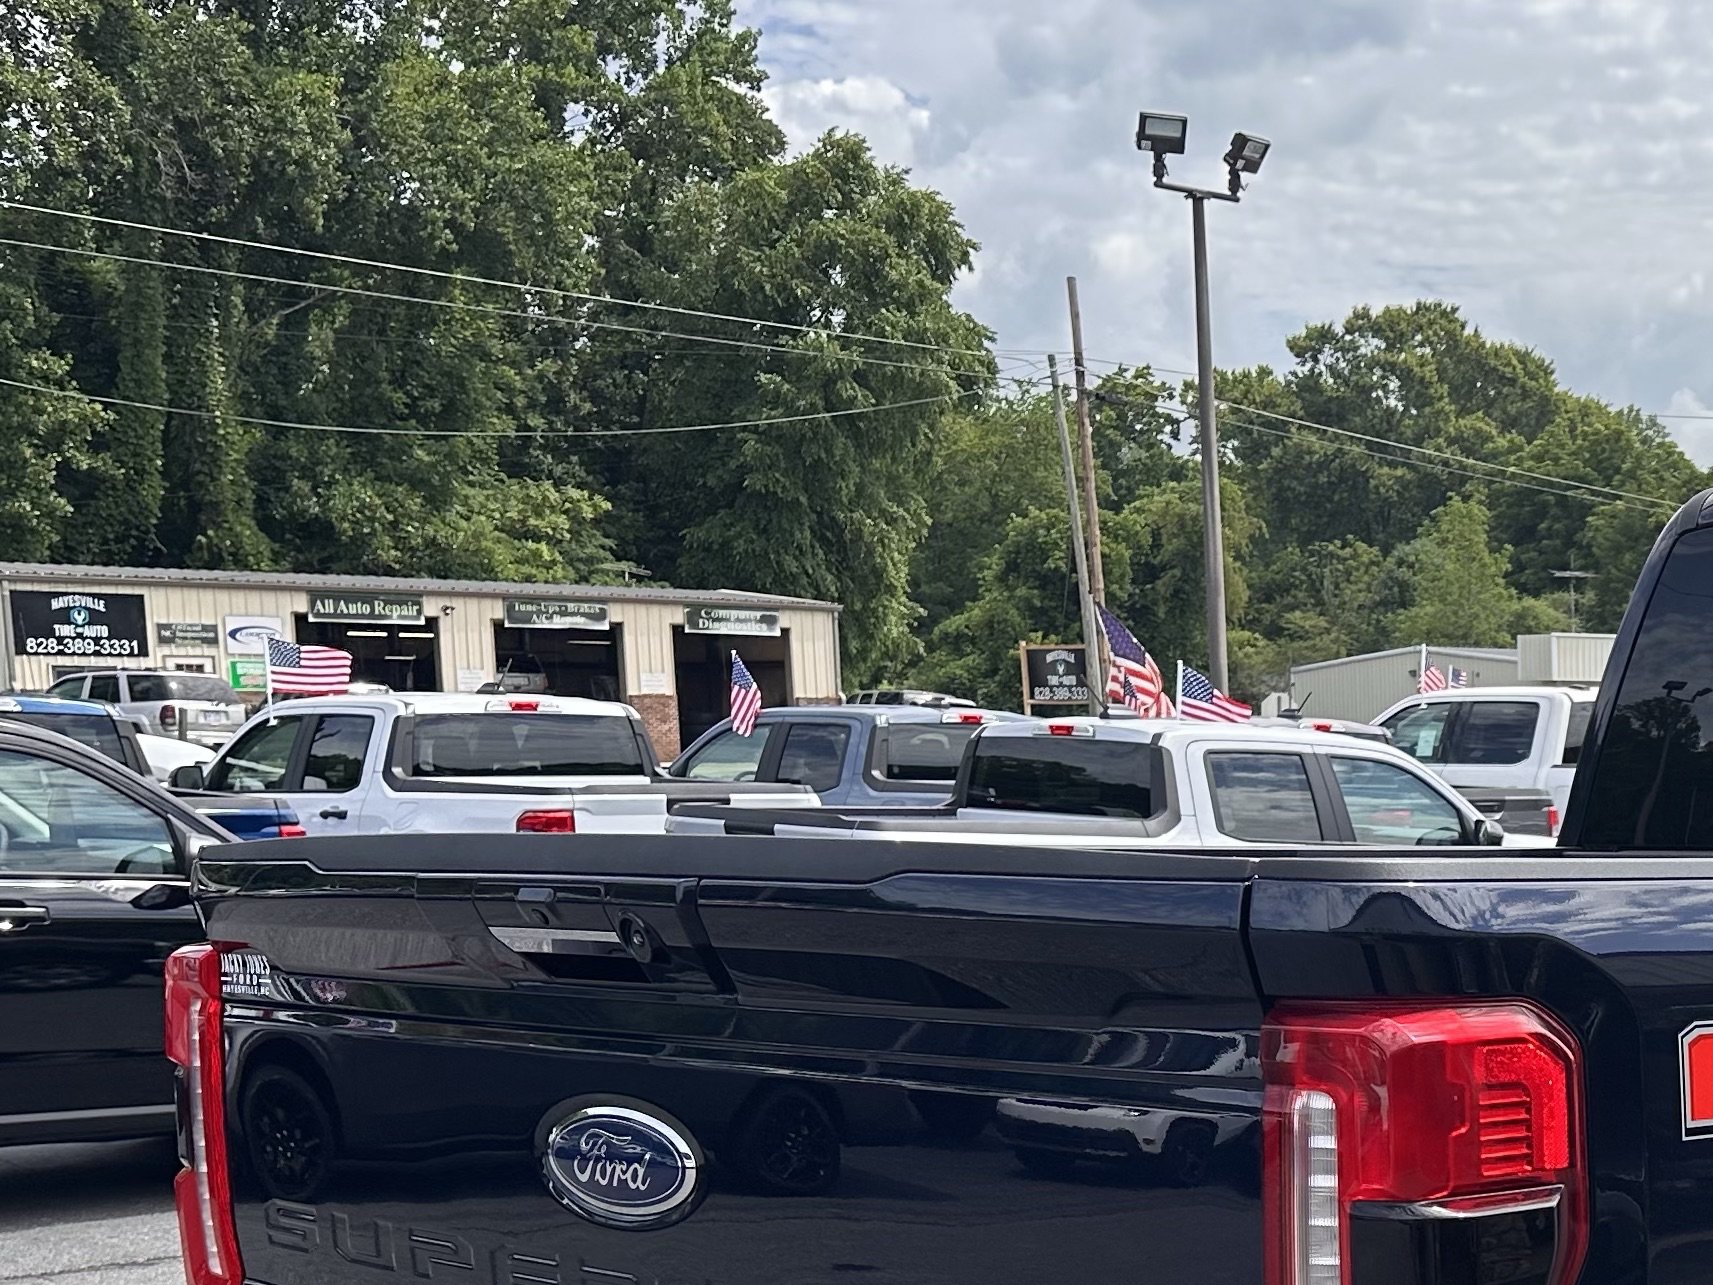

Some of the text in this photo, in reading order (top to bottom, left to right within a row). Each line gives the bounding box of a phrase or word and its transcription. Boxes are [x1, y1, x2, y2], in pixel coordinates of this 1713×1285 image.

[51, 595, 106, 612] HAYESVILLE
[313, 599, 419, 619] All Auto Repair
[531, 614, 550, 623] A/C
[701, 609, 760, 620] Computer
[699, 619, 768, 629] Diagnostics
[53, 625, 76, 637] TIRE
[83, 625, 108, 637] AUTO
[26, 638, 139, 655] 828-389-3331
[1034, 687, 1088, 700] 828-389-333
[220, 953, 270, 975] JACKY JONES
[233, 974, 258, 985] FORD
[573, 1128, 651, 1191] Ford
